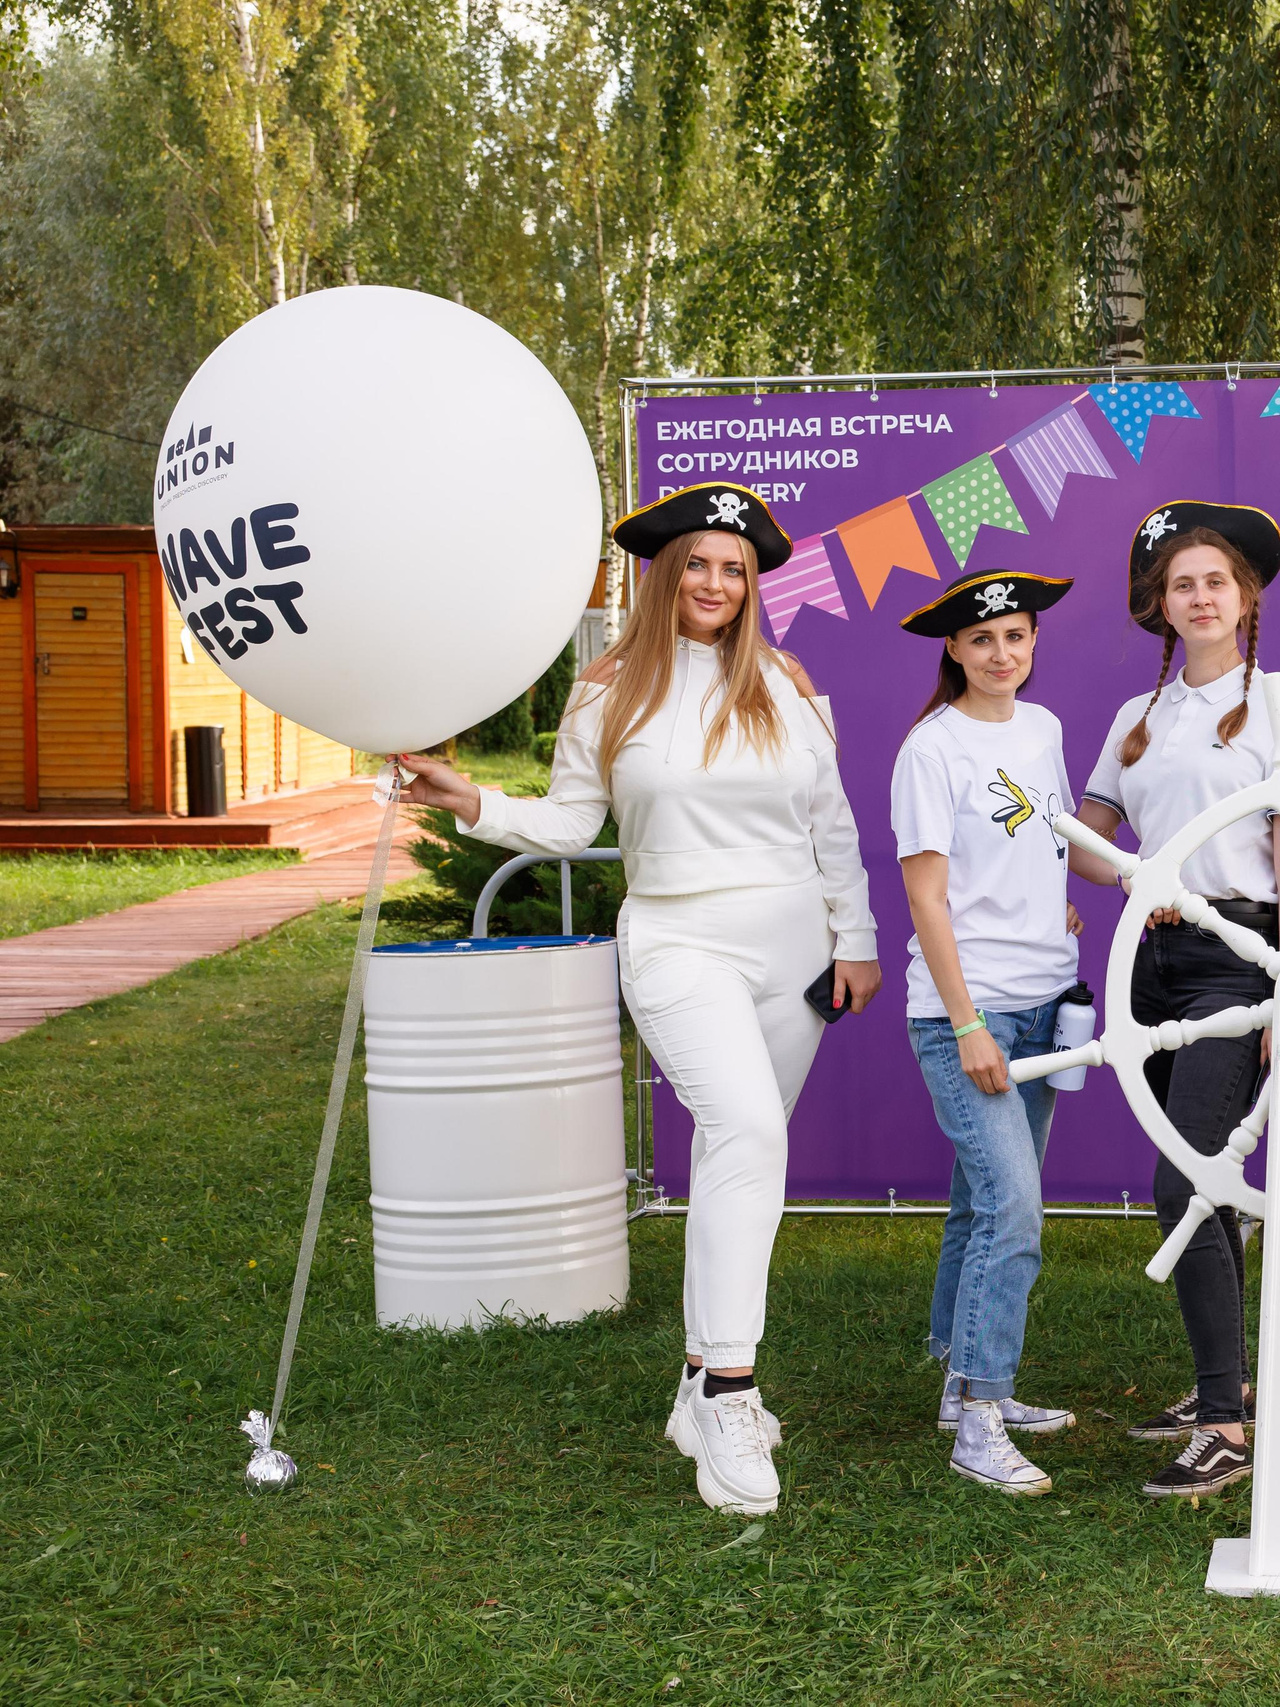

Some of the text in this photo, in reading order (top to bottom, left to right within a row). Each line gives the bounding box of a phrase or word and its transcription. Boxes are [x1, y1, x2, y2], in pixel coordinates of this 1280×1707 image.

[657, 413, 954, 442] ЕЖЕГОДНАЯ ВСТРЕЧА
[156, 441, 235, 501] UNION
[657, 448, 859, 474] СОТРУДНИКОВ
[187, 580, 309, 666] FEST
